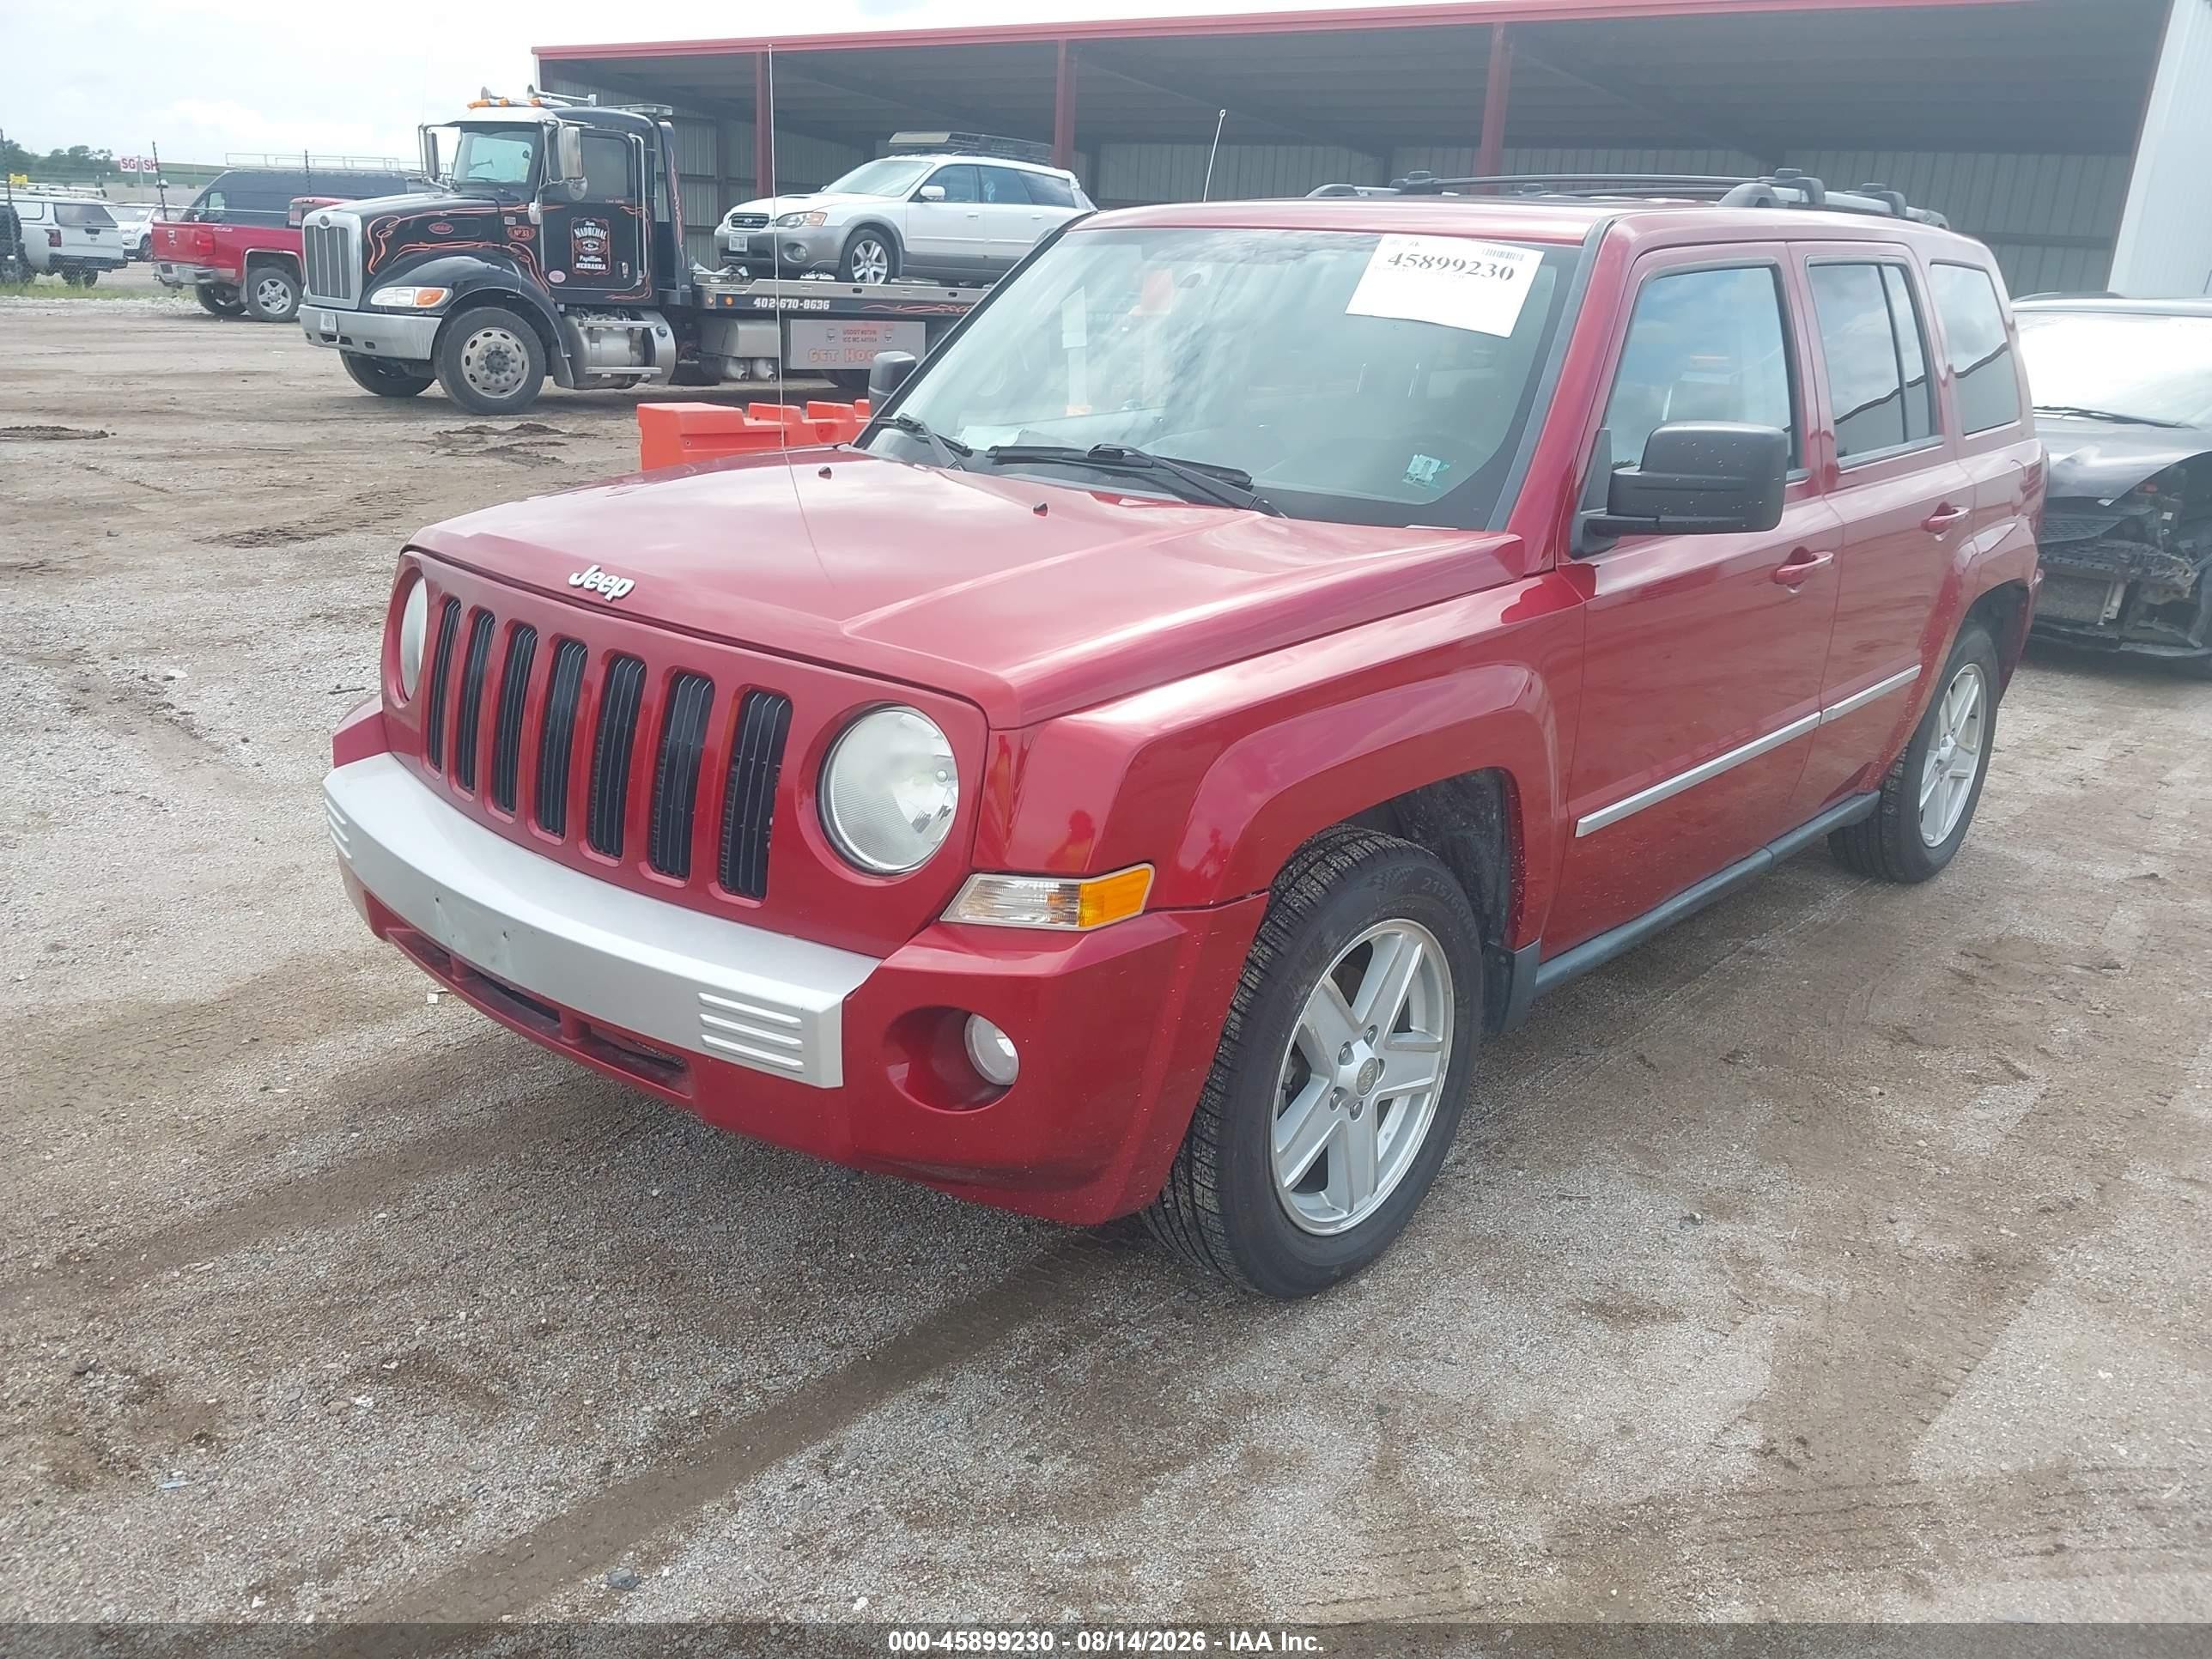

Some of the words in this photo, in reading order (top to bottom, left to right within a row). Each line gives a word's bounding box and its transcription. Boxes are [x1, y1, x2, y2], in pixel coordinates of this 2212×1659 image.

[122, 158, 136, 169] SG
[144, 160, 157, 171] SH
[1388, 252, 1515, 281] 45899230
[568, 564, 635, 603] Jeep
